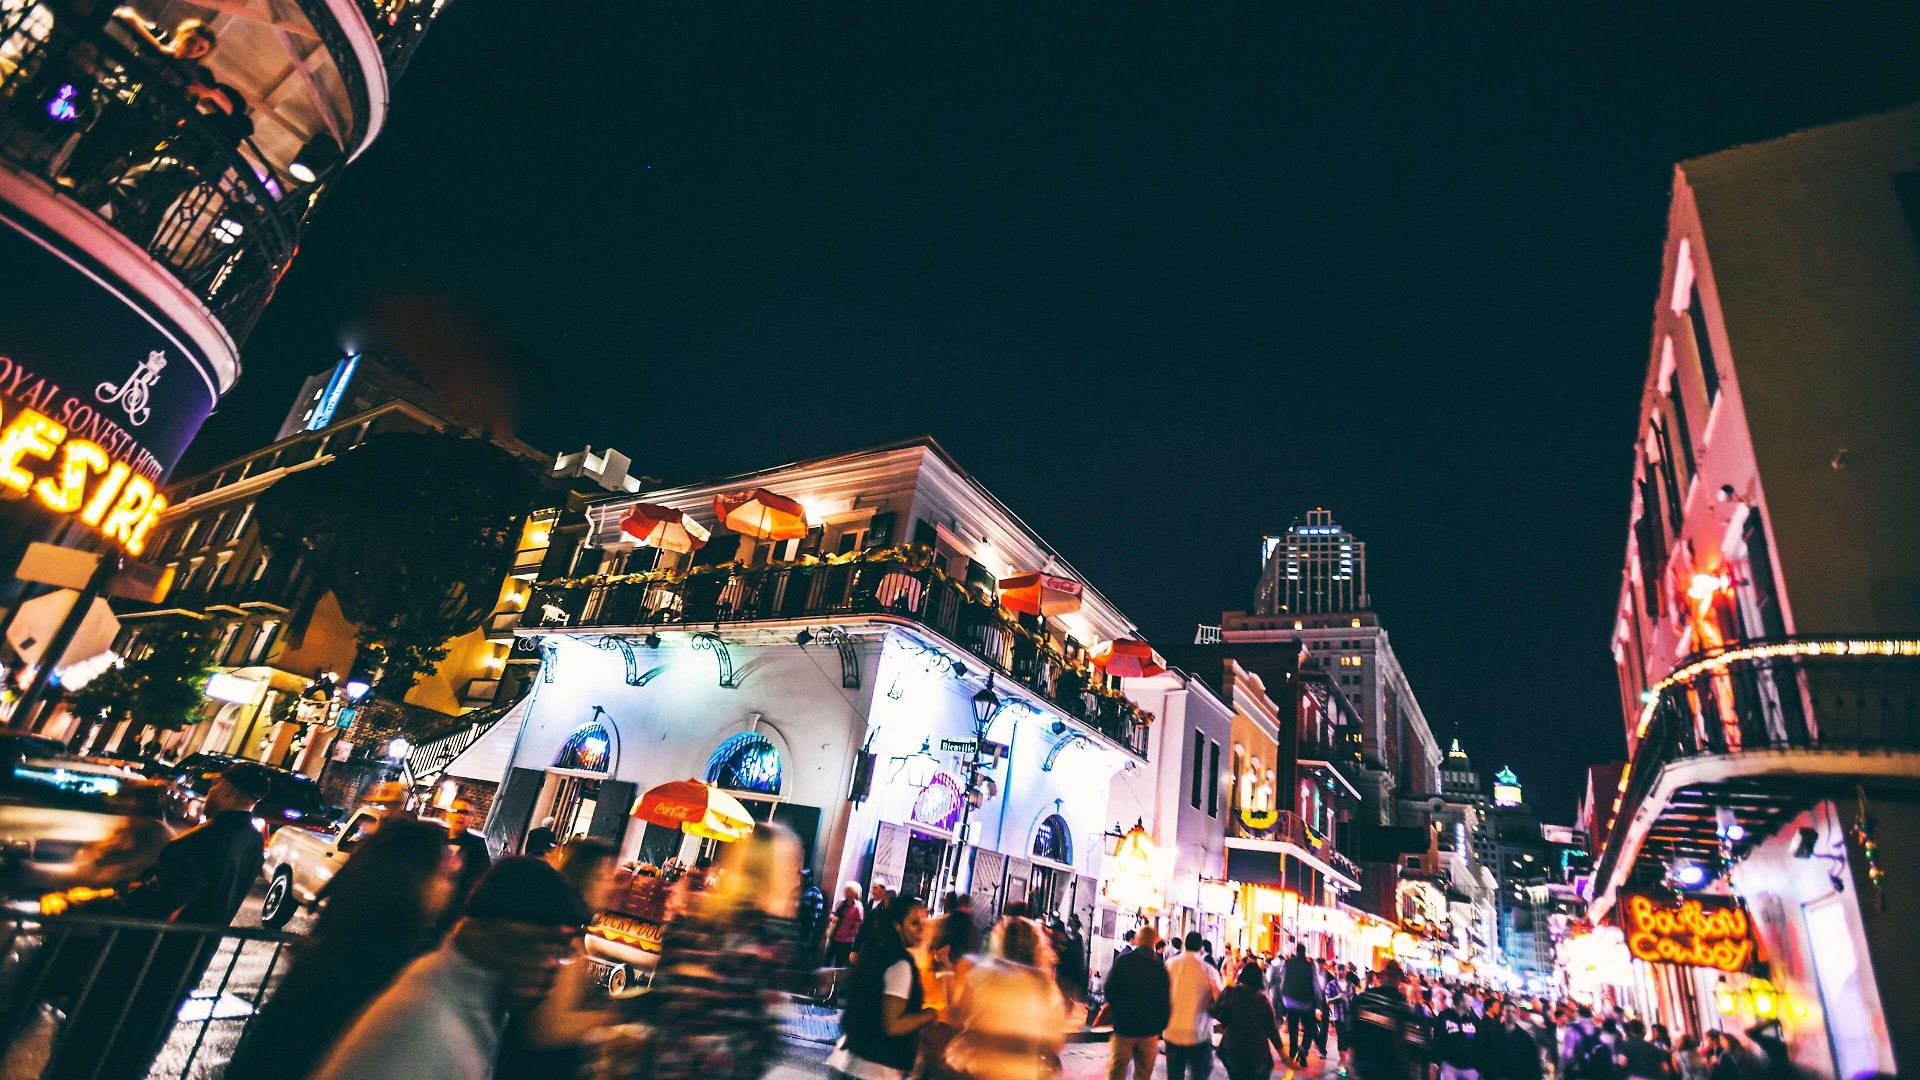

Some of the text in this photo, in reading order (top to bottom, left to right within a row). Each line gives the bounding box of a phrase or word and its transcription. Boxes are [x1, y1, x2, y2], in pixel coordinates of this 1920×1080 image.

[0, 356, 163, 484] OYAL SONESTA HOTEL
[0, 402, 168, 556] ESIRE
[942, 741, 975, 753] Bienville
